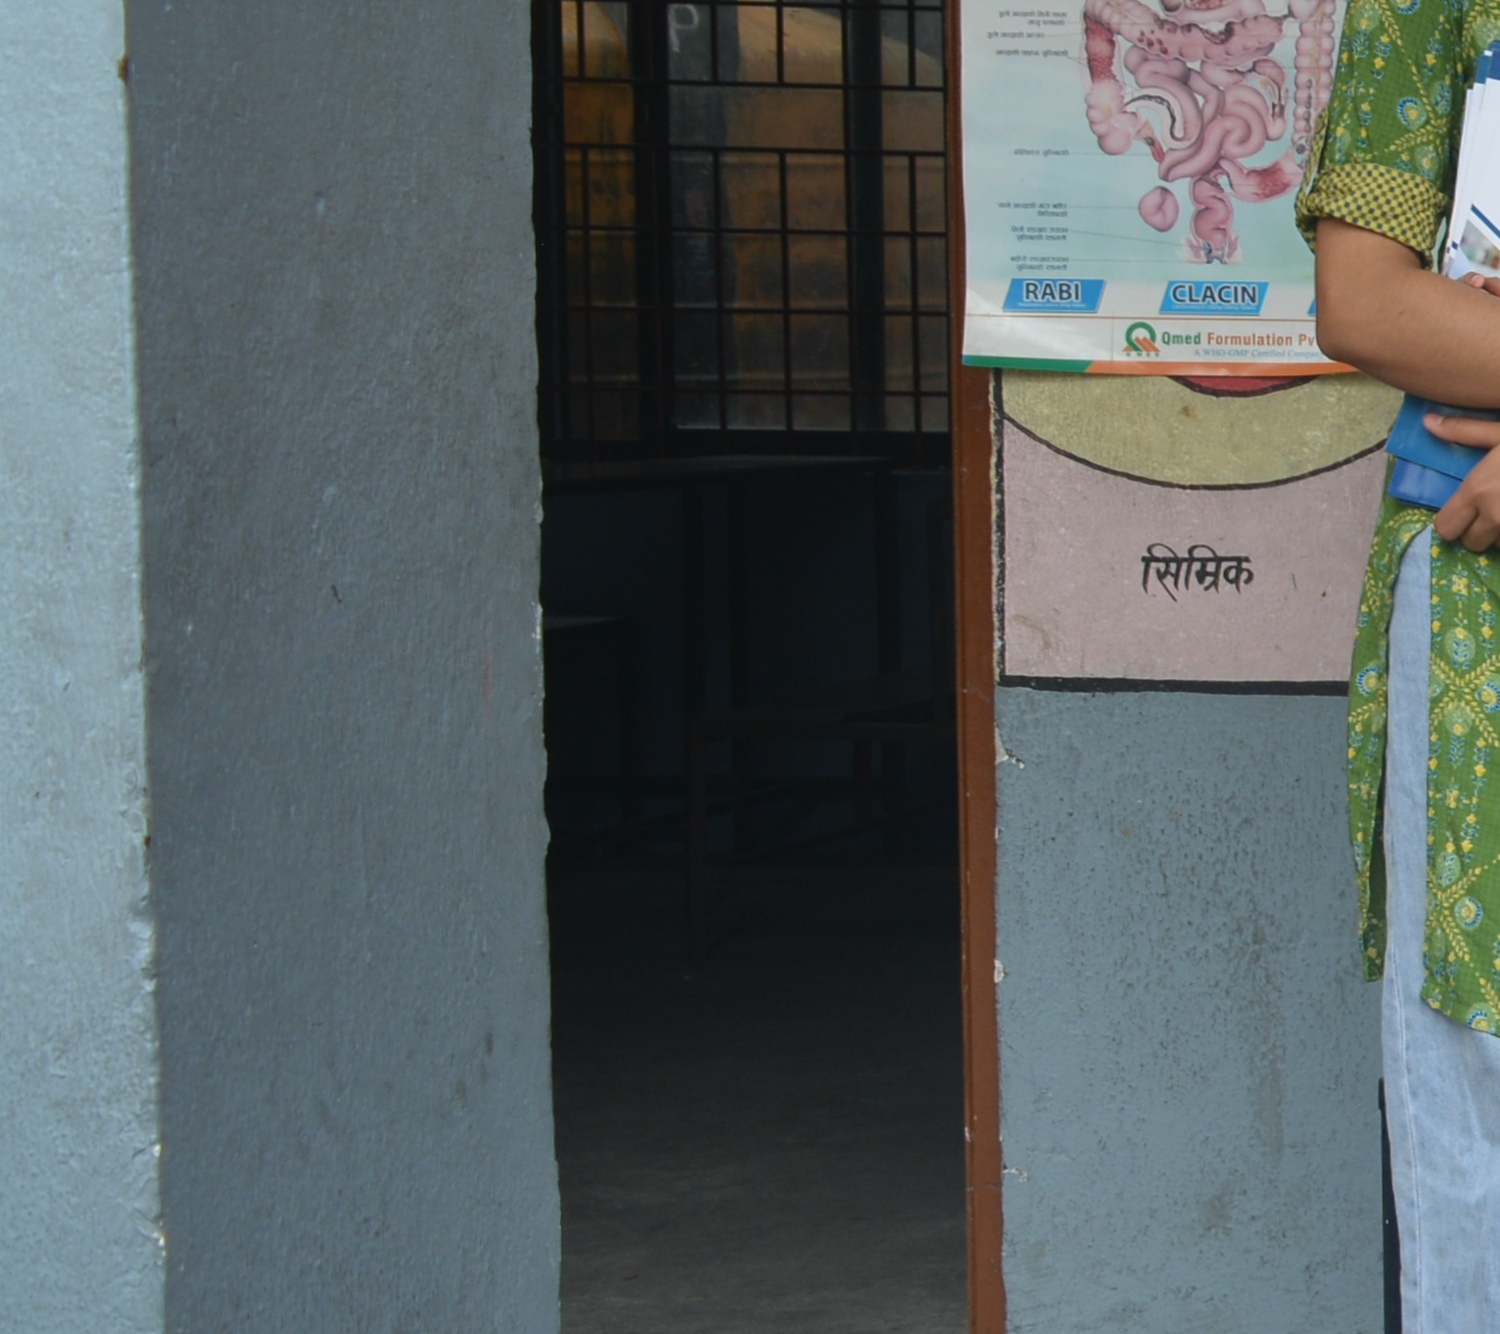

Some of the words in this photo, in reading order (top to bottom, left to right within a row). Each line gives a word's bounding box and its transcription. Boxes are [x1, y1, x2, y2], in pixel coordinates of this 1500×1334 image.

[1023, 281, 1081, 302] RABI
[1170, 282, 1258, 305] CLACIN
[1161, 330, 1202, 346] Qmed
[1206, 331, 1294, 347] Formulation
